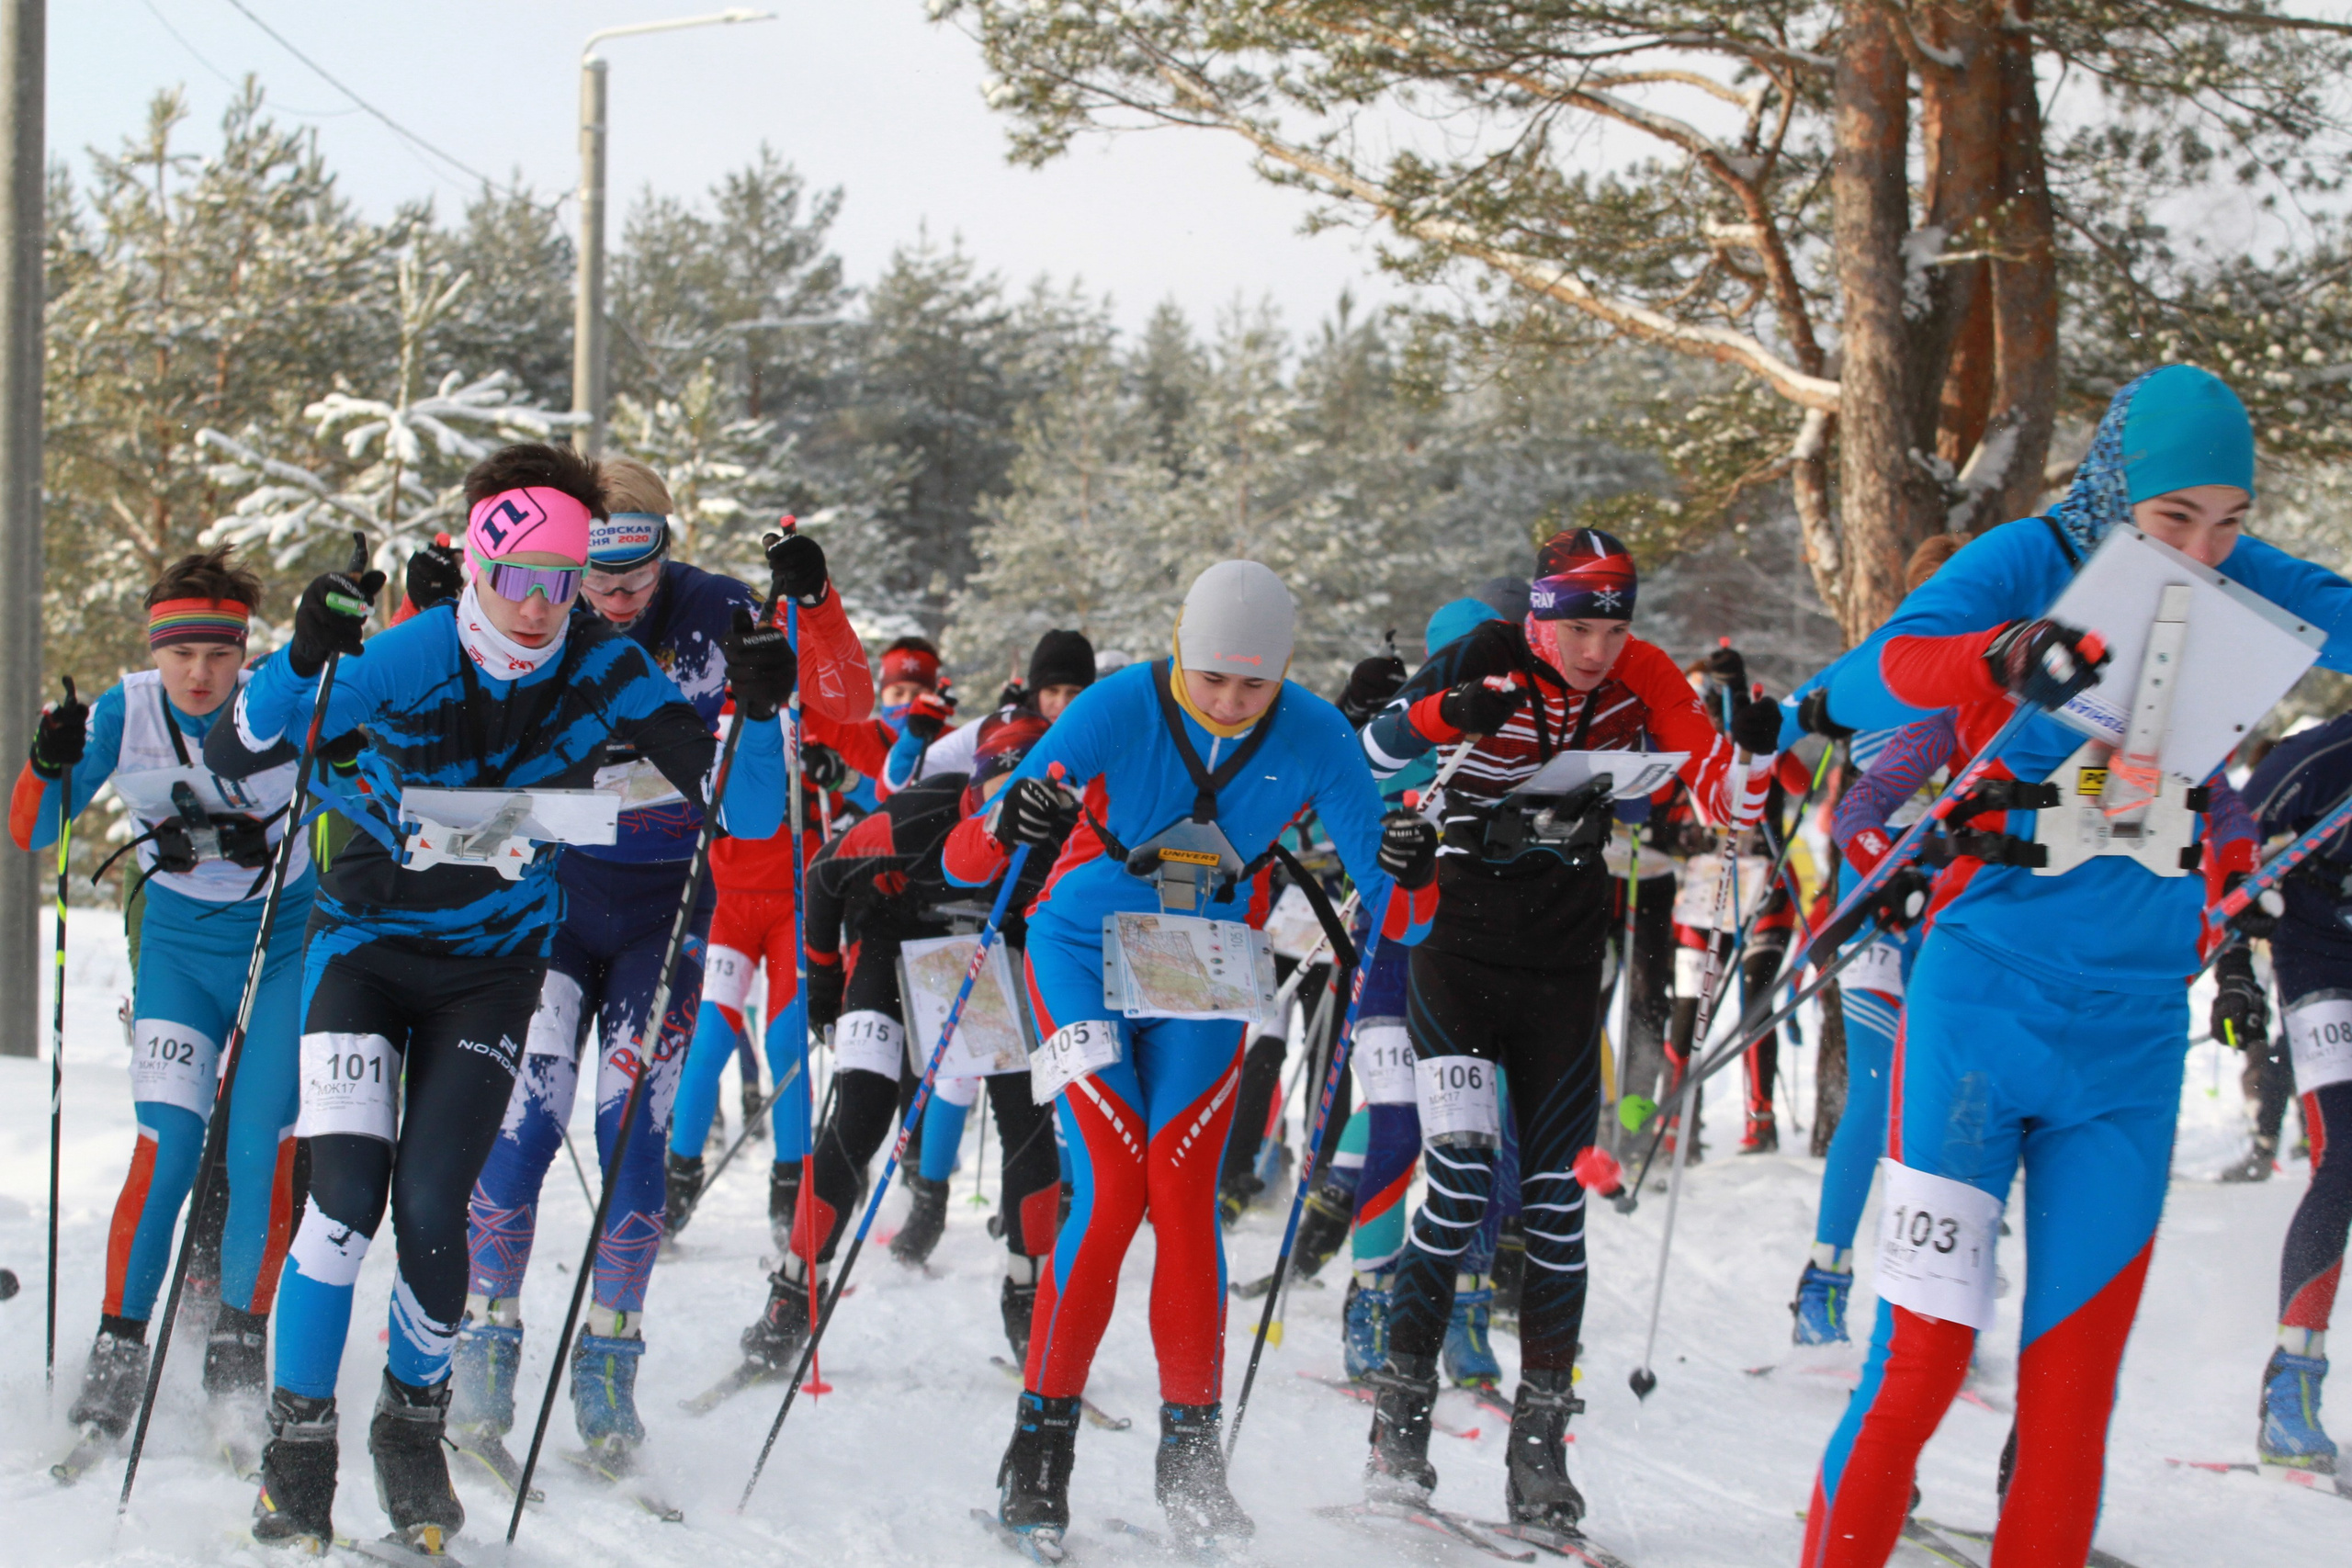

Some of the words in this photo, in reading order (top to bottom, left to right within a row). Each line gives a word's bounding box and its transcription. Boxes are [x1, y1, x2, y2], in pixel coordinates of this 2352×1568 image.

[617, 535, 650, 544] 2020
[1162, 850, 1216, 862] UNIVERS
[850, 1020, 889, 1042] 115
[1047, 1021, 1091, 1061] 105
[2309, 1021, 2352, 1047] 108
[149, 1036, 194, 1066] 102
[1374, 1047, 1414, 1066] 116
[327, 1053, 381, 1084] 101
[1434, 1066, 1483, 1090] 106
[317, 1083, 356, 1096] МЖ17
[1894, 1204, 1958, 1254] 103
